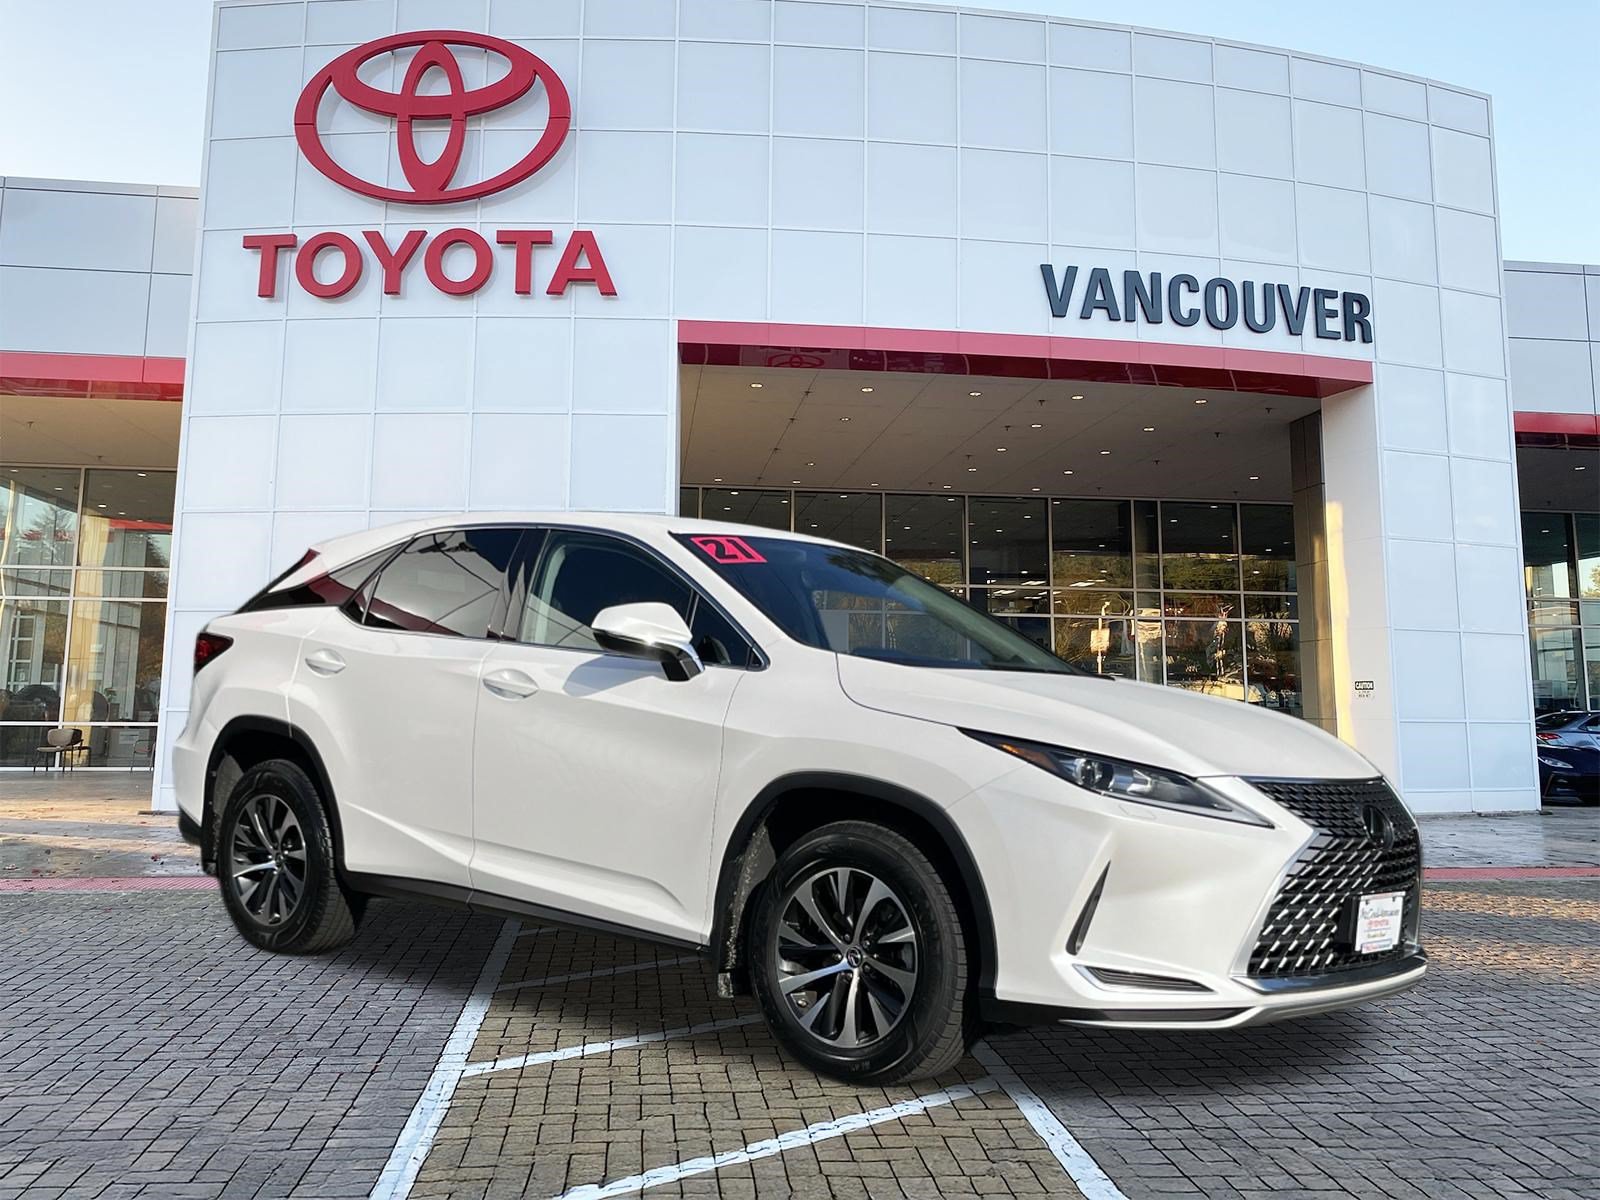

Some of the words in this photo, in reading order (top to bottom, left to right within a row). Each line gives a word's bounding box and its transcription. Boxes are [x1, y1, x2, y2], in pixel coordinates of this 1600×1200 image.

[243, 228, 618, 299] TOYOTA
[1040, 264, 1373, 344] VANCOUVER
[699, 538, 755, 560] 21
